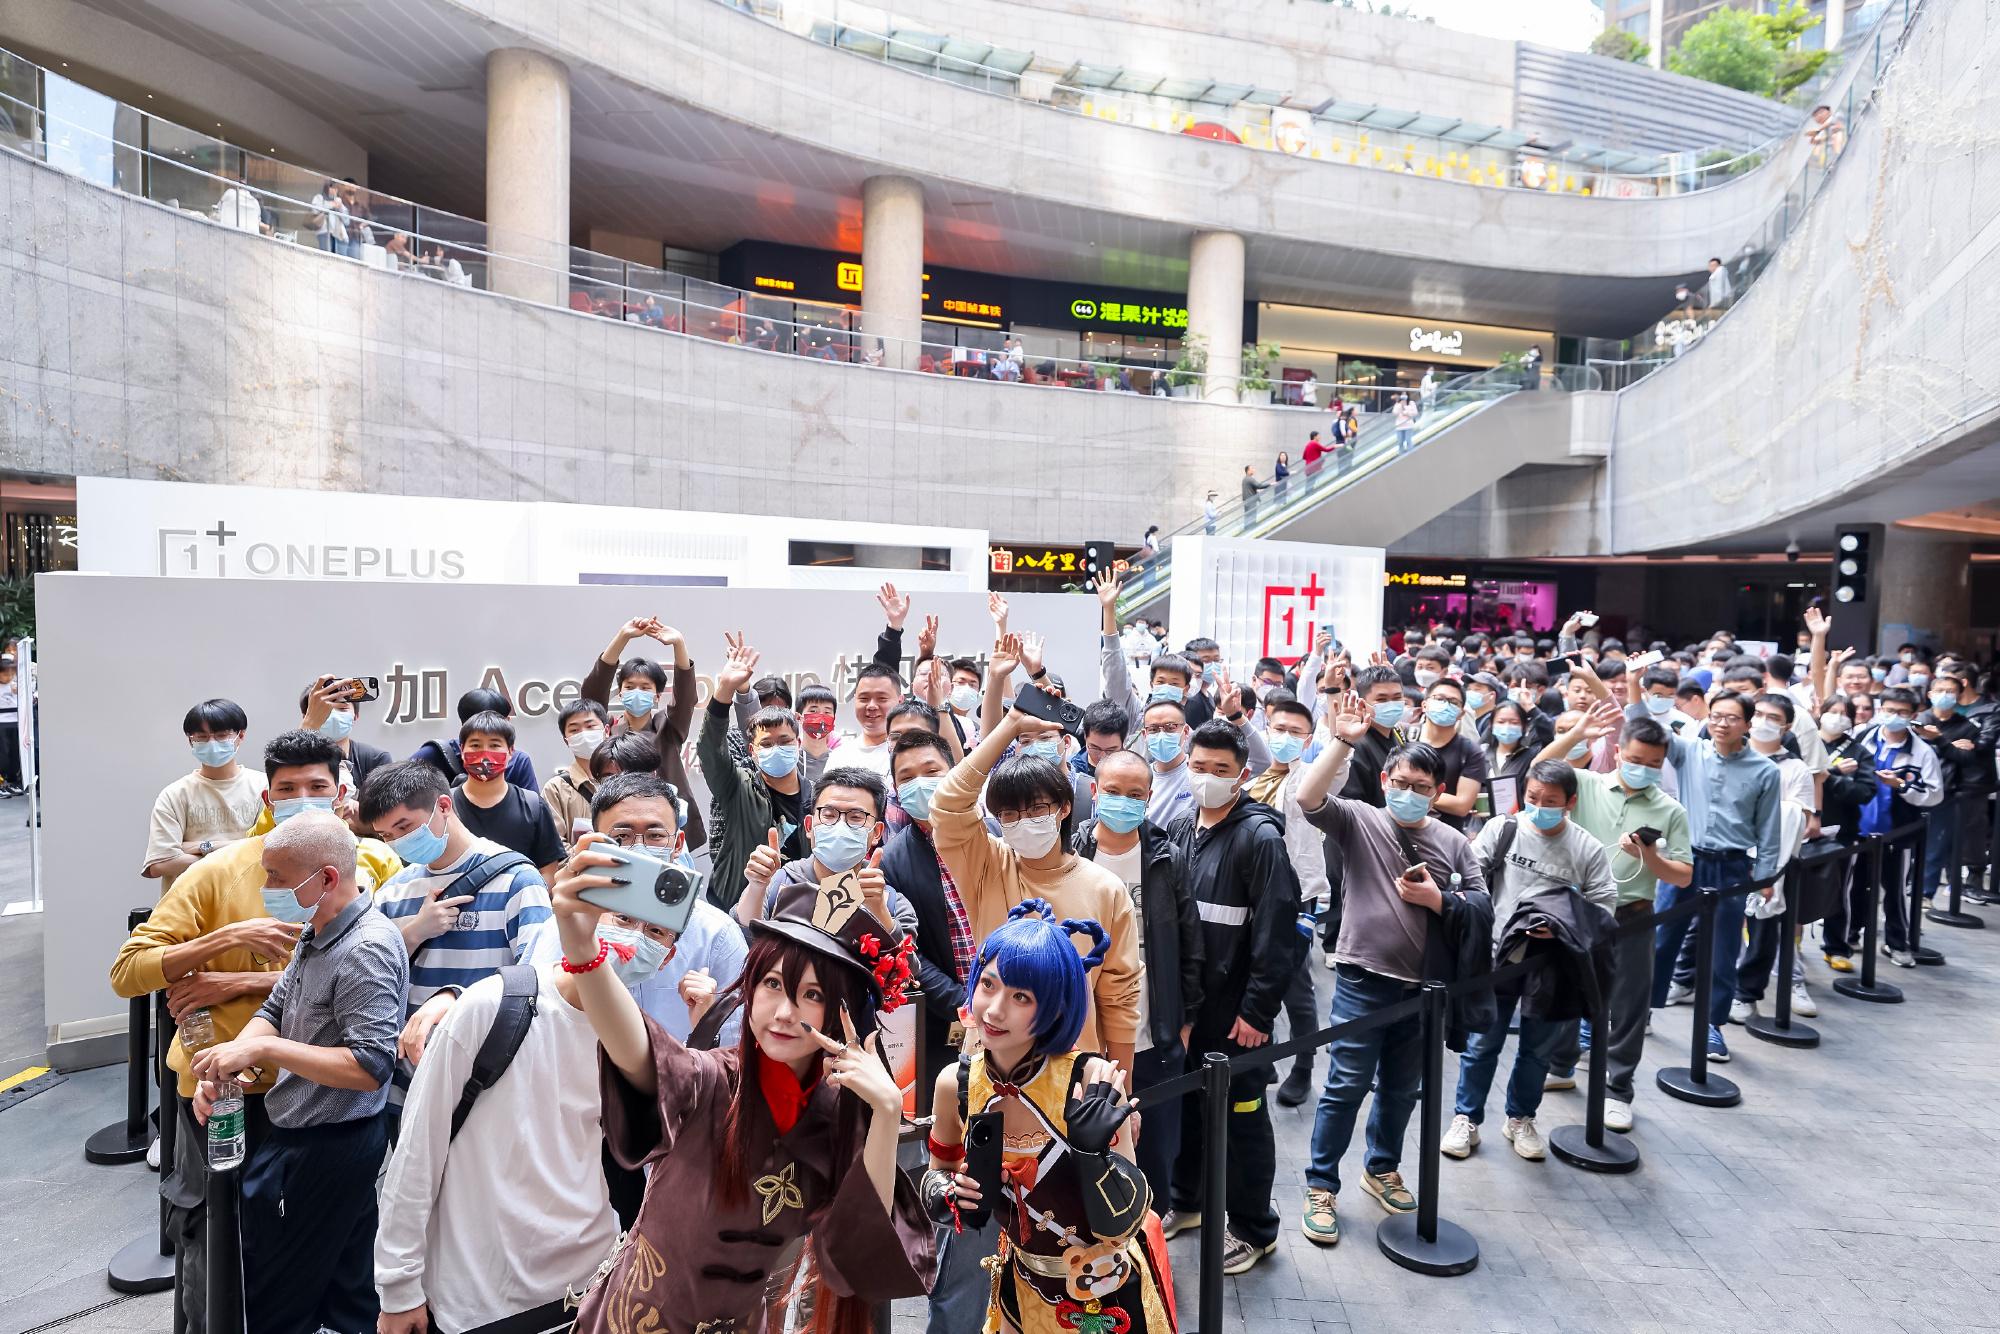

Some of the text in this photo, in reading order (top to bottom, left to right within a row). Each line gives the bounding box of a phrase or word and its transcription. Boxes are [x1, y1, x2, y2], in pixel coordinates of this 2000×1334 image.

[245, 542, 466, 580] ONEPLUS
[1015, 551, 1076, 571] 八合里
[384, 664, 447, 725] 加
[478, 667, 583, 718] Ace
